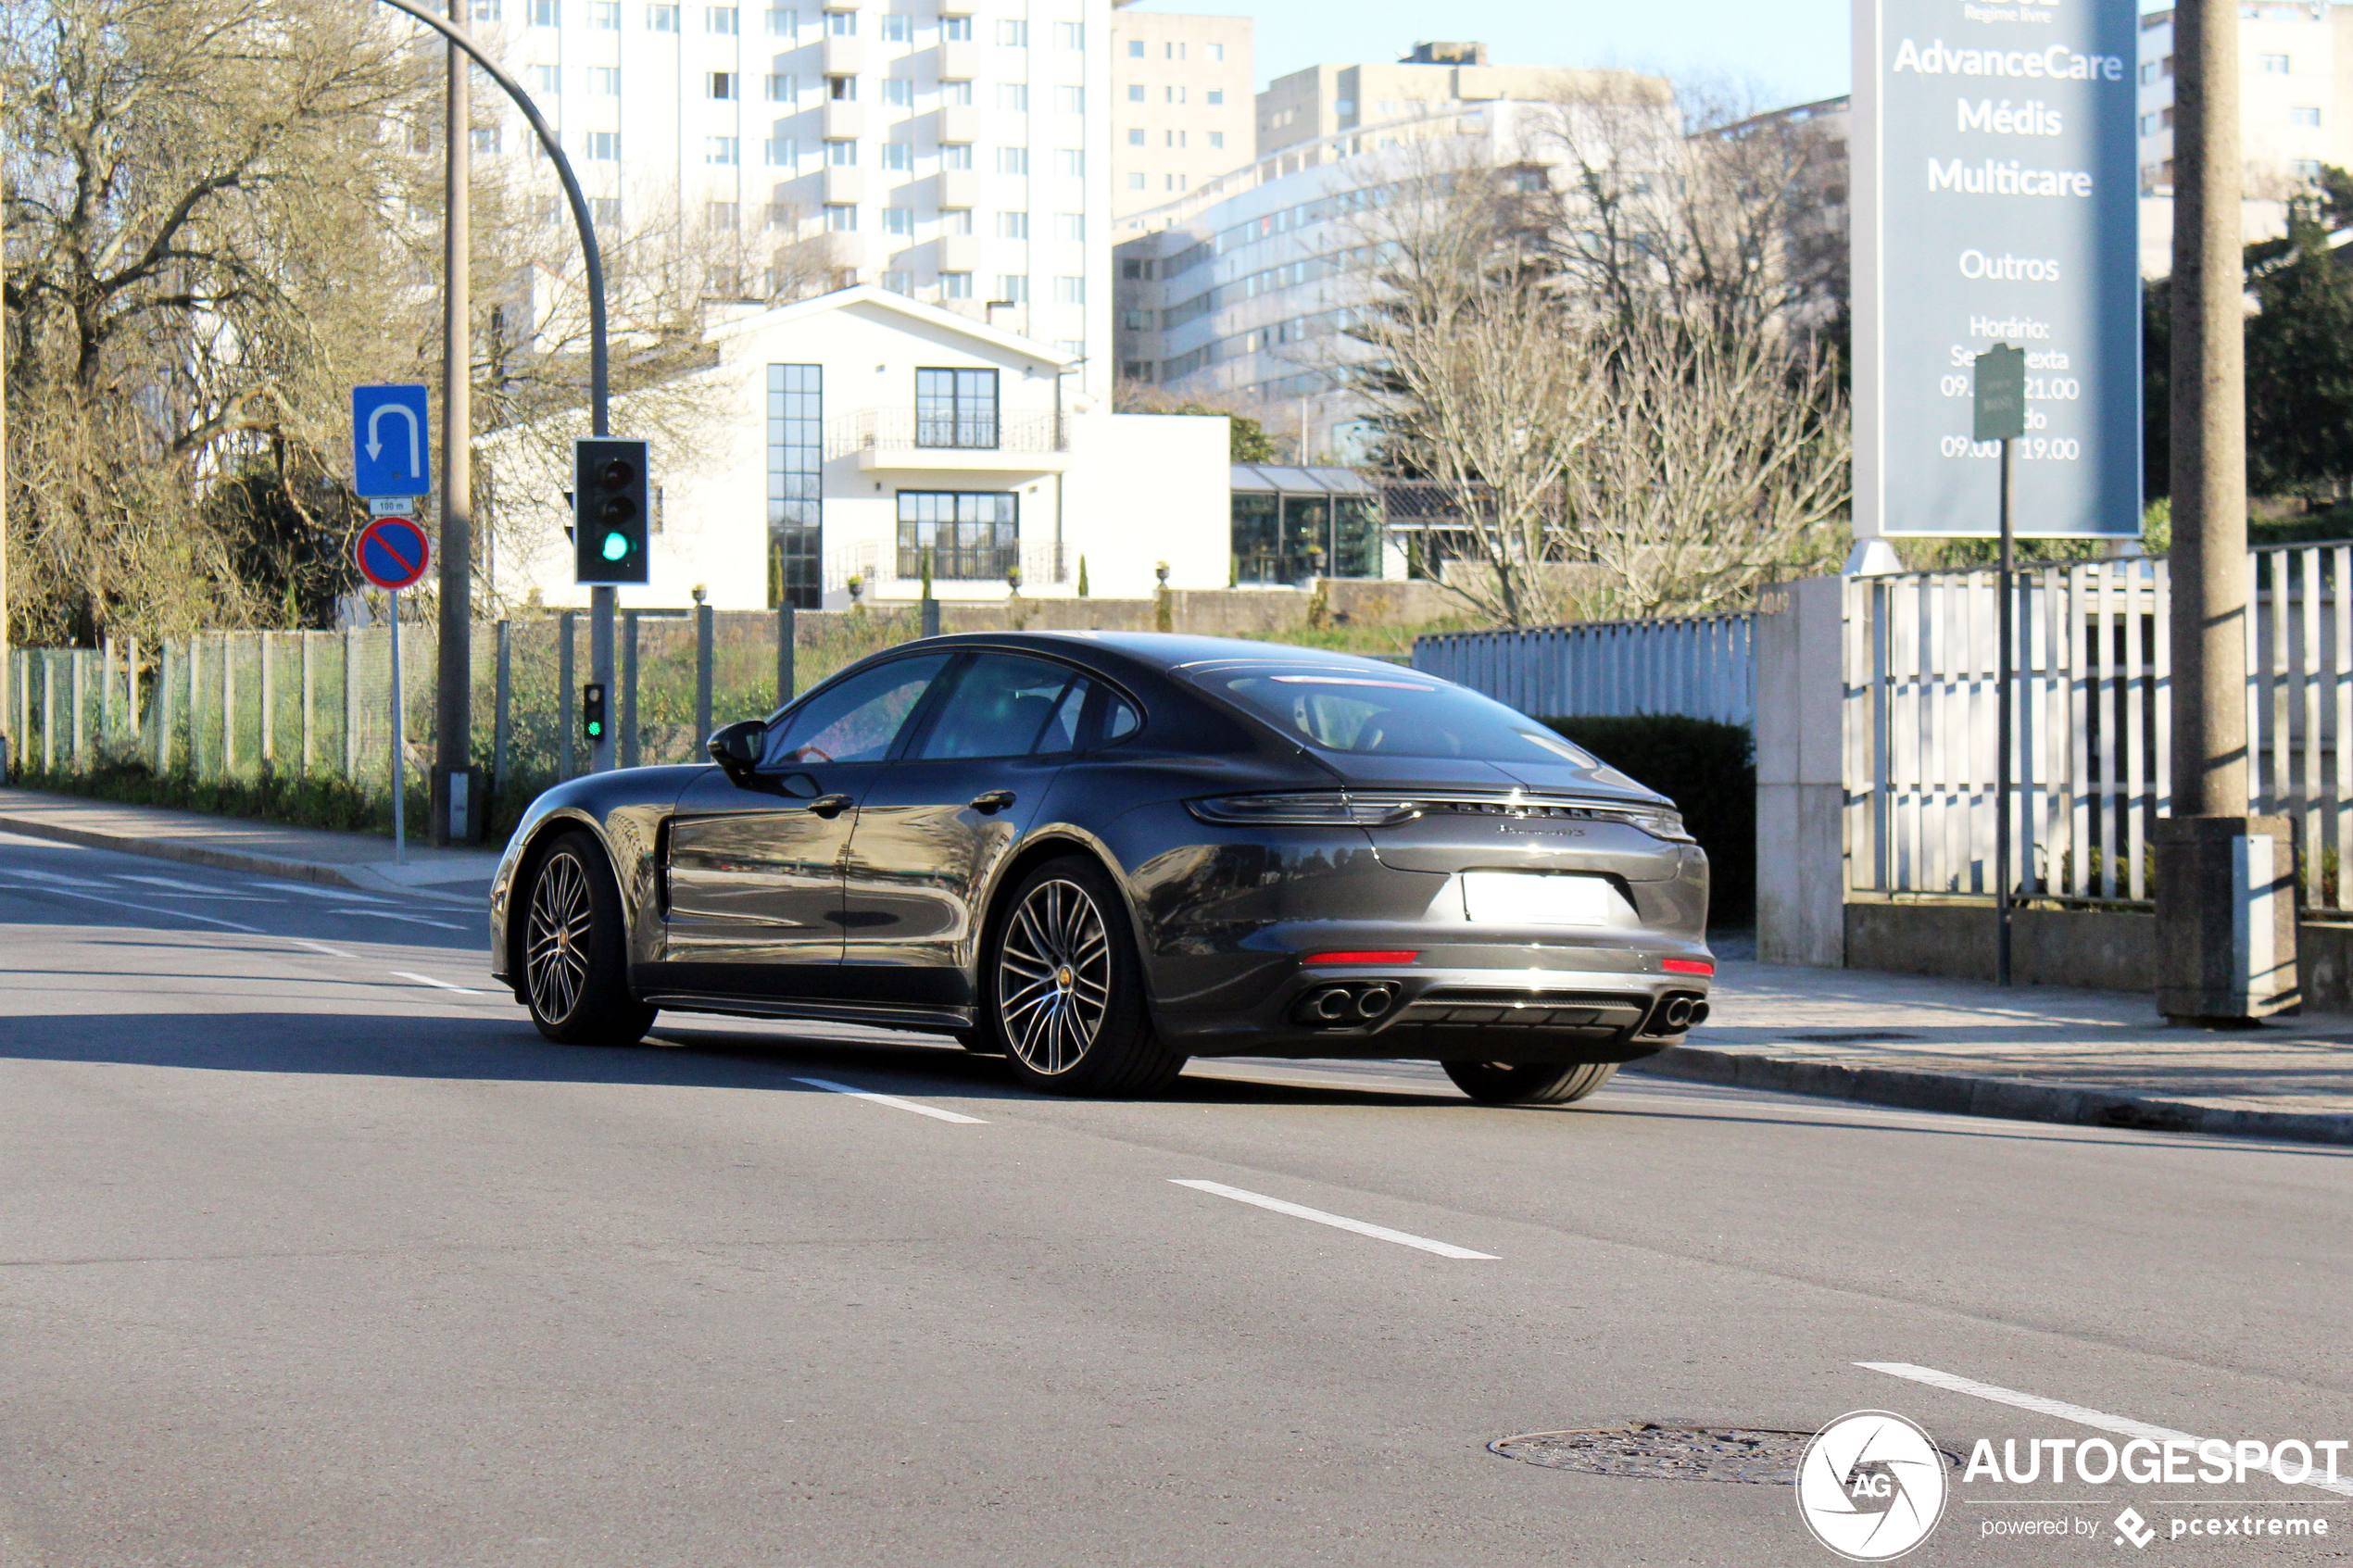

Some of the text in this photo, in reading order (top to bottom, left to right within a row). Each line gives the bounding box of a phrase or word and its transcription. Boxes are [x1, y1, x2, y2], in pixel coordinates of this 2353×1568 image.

[2020, 6, 2052, 23] livre
[1894, 39, 2123, 82] AdvanceCare
[1957, 97, 2062, 136] Médis
[1927, 157, 2093, 197] Multicare
[1959, 248, 2059, 282] Outros
[1969, 315, 2050, 339] Horário:
[1950, 345, 2070, 370] Se exta
[1940, 374, 1975, 397] 09.
[2024, 376, 2080, 400] 21.00
[1940, 434, 2080, 460] 09.00 19.00
